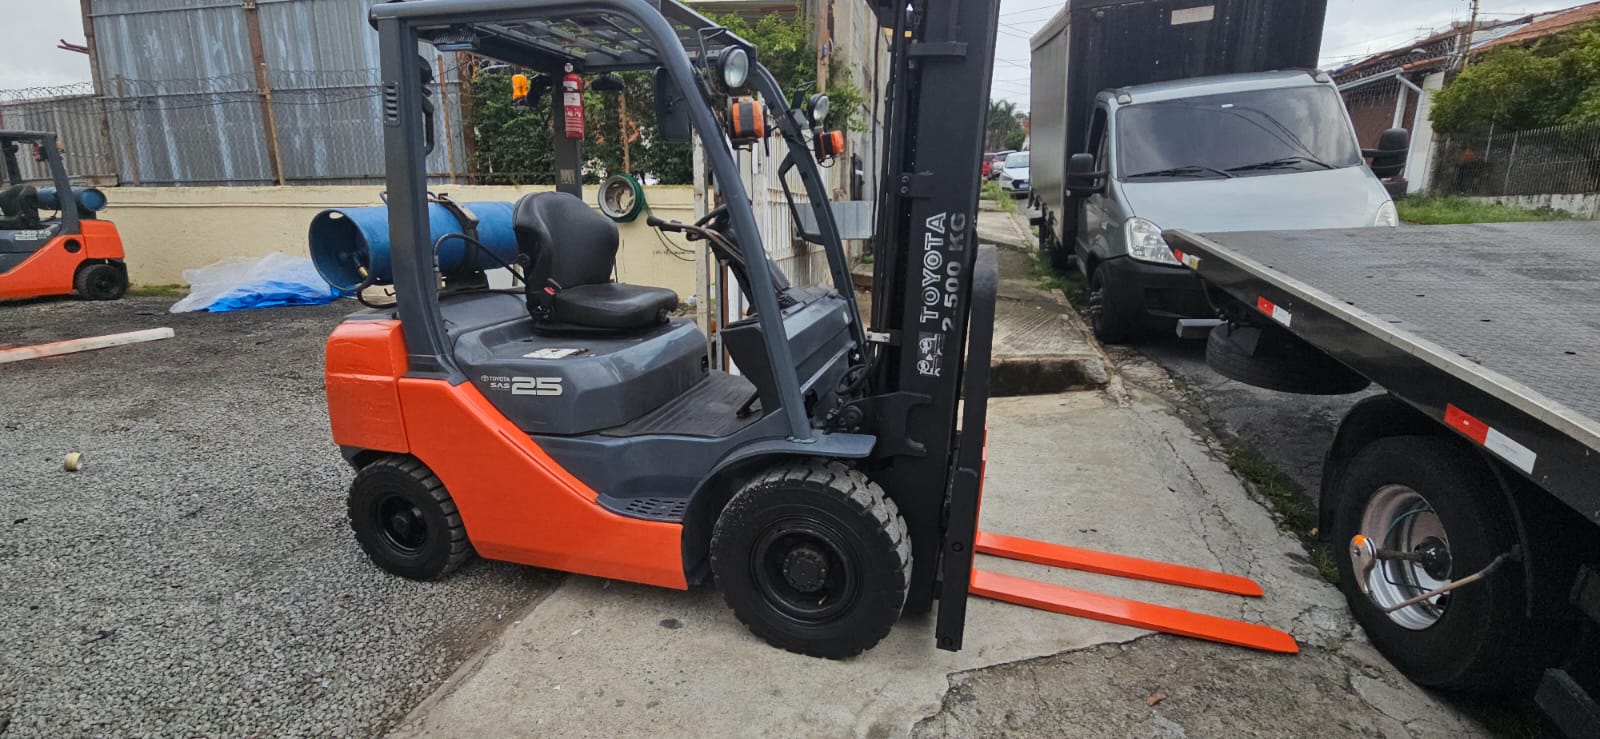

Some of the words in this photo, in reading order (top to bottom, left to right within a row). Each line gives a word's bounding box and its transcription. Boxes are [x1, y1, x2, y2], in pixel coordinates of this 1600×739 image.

[948, 213, 966, 251] KG
[920, 212, 947, 323] TOYOTA
[512, 376, 563, 396] 25
